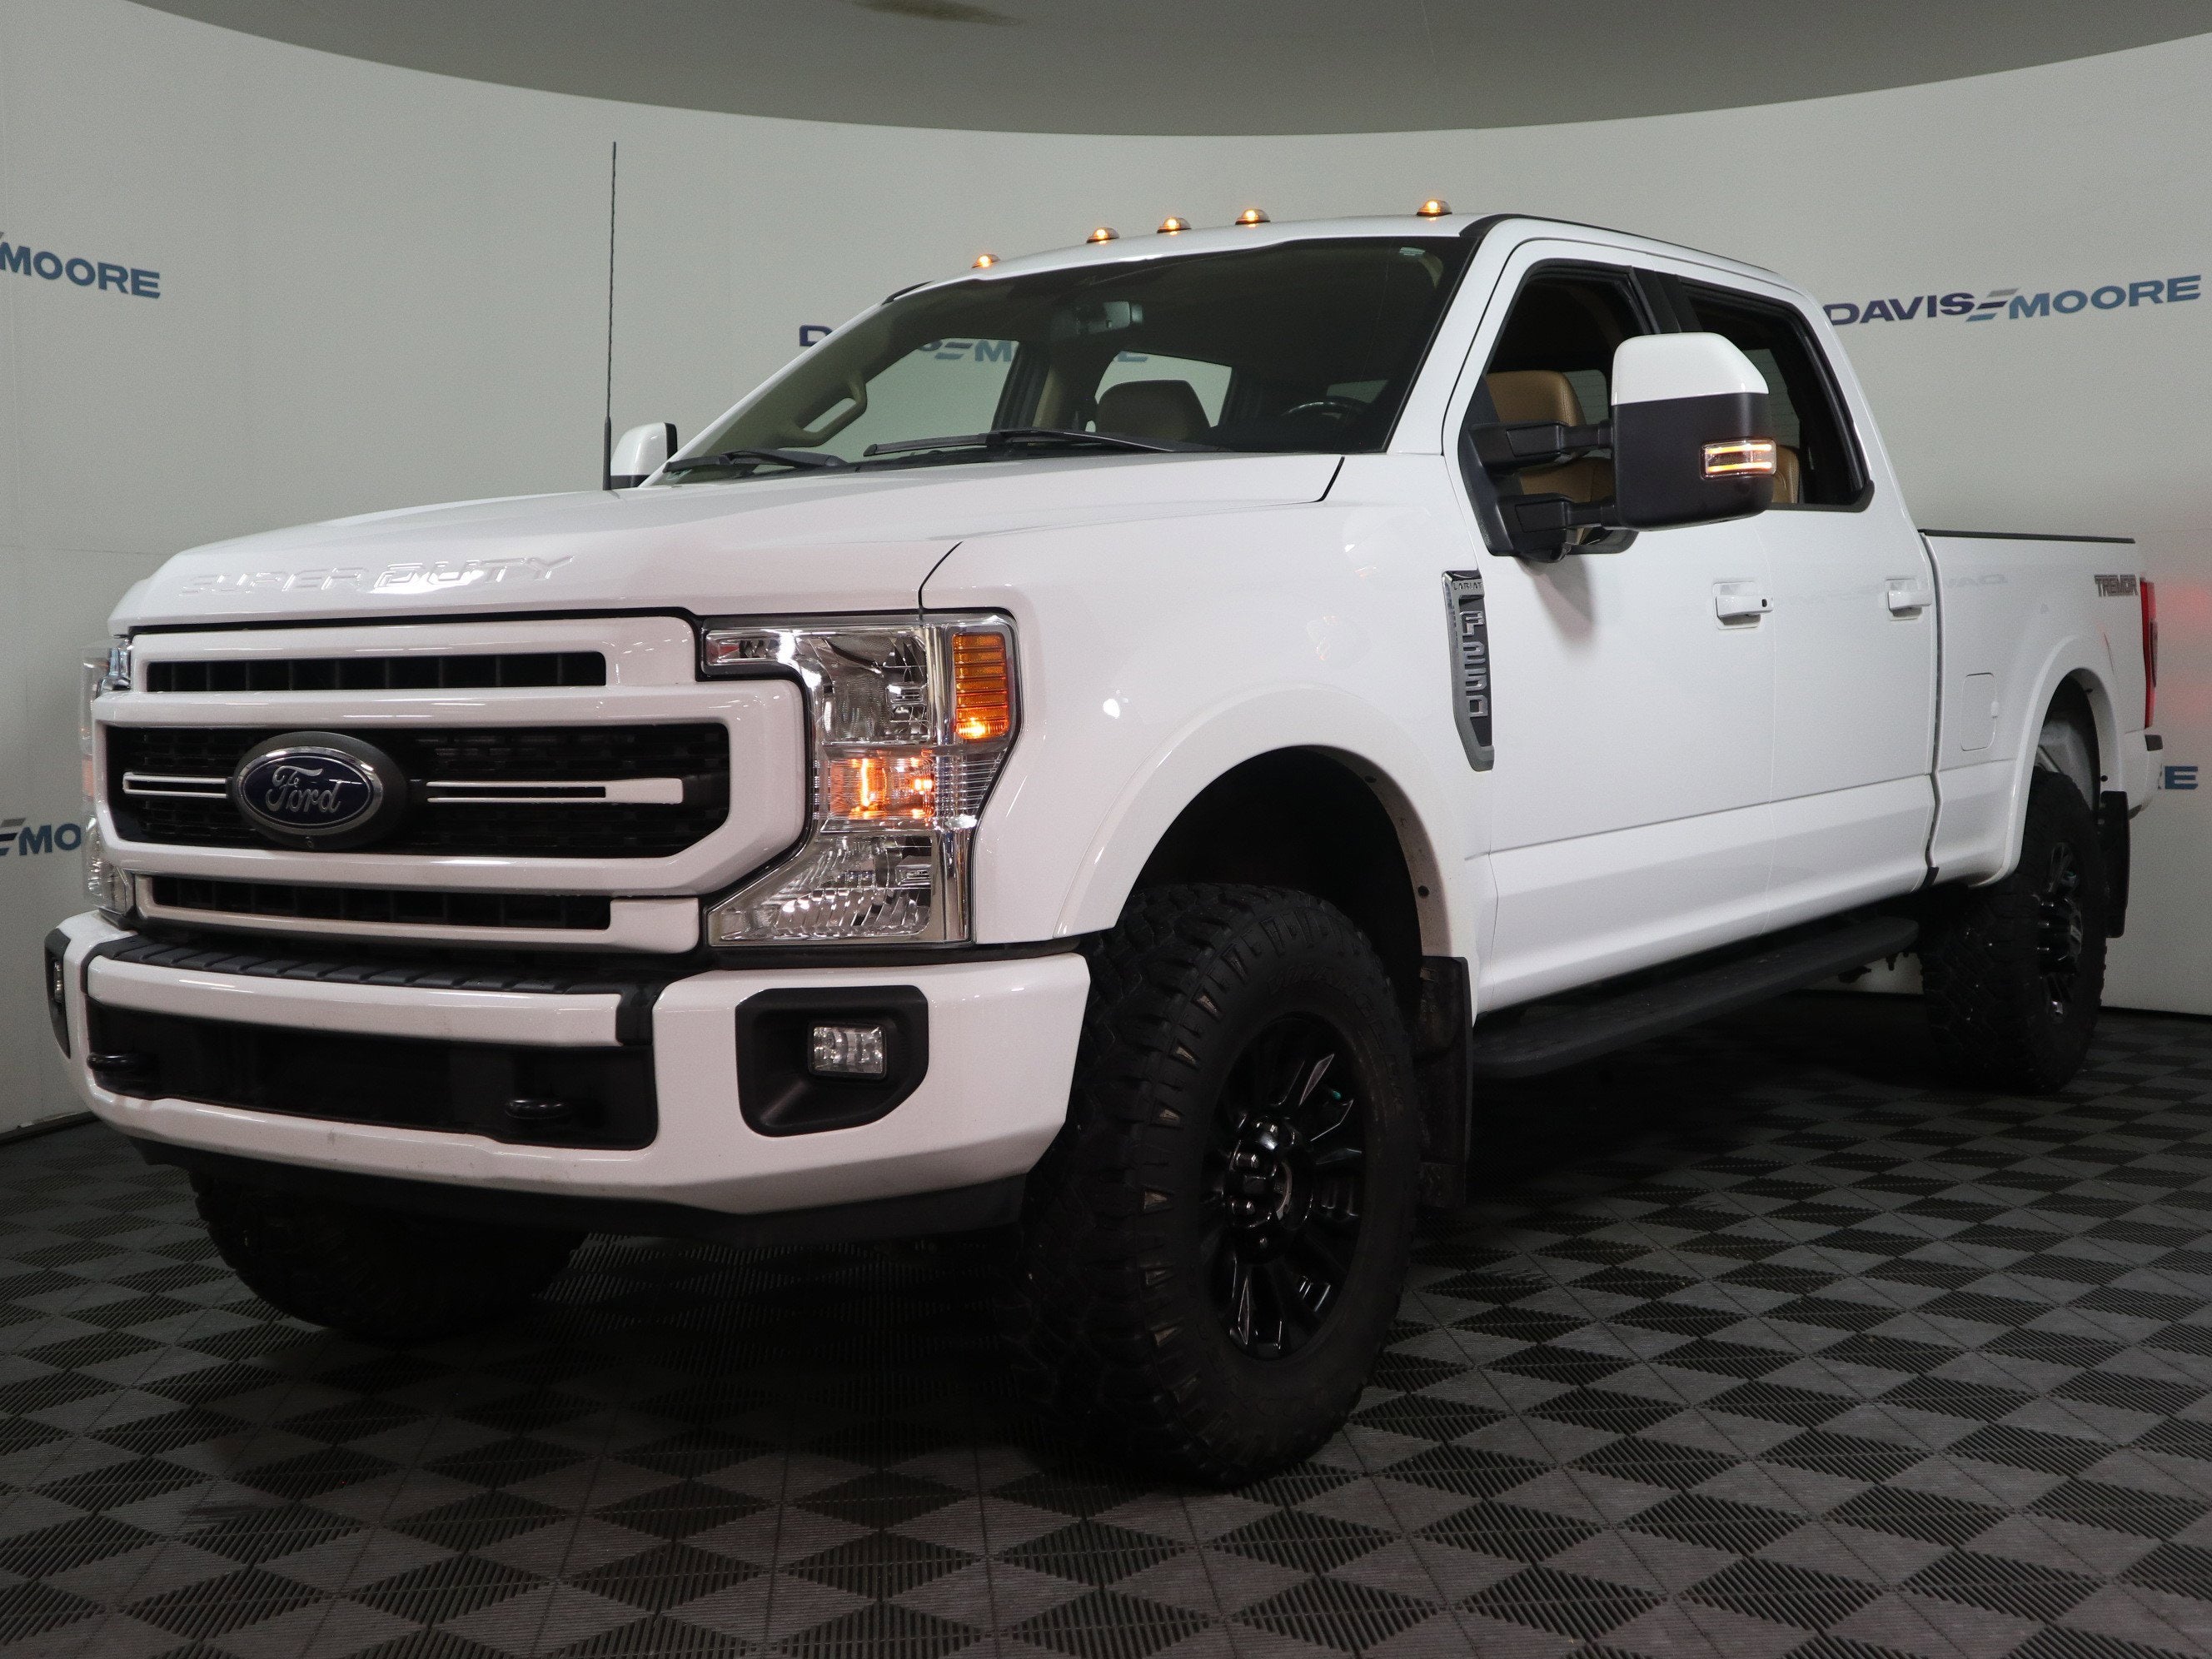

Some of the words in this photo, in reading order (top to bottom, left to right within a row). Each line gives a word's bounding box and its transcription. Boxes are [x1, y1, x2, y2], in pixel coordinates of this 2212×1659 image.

[0, 241, 162, 299] MOORE
[1823, 291, 1975, 326] DAVIS
[2008, 274, 2202, 320] MOORE
[177, 566, 369, 596] SUPER
[371, 555, 575, 594] DUTY
[1452, 581, 1482, 590] LARIAT
[265, 765, 342, 814] Ford
